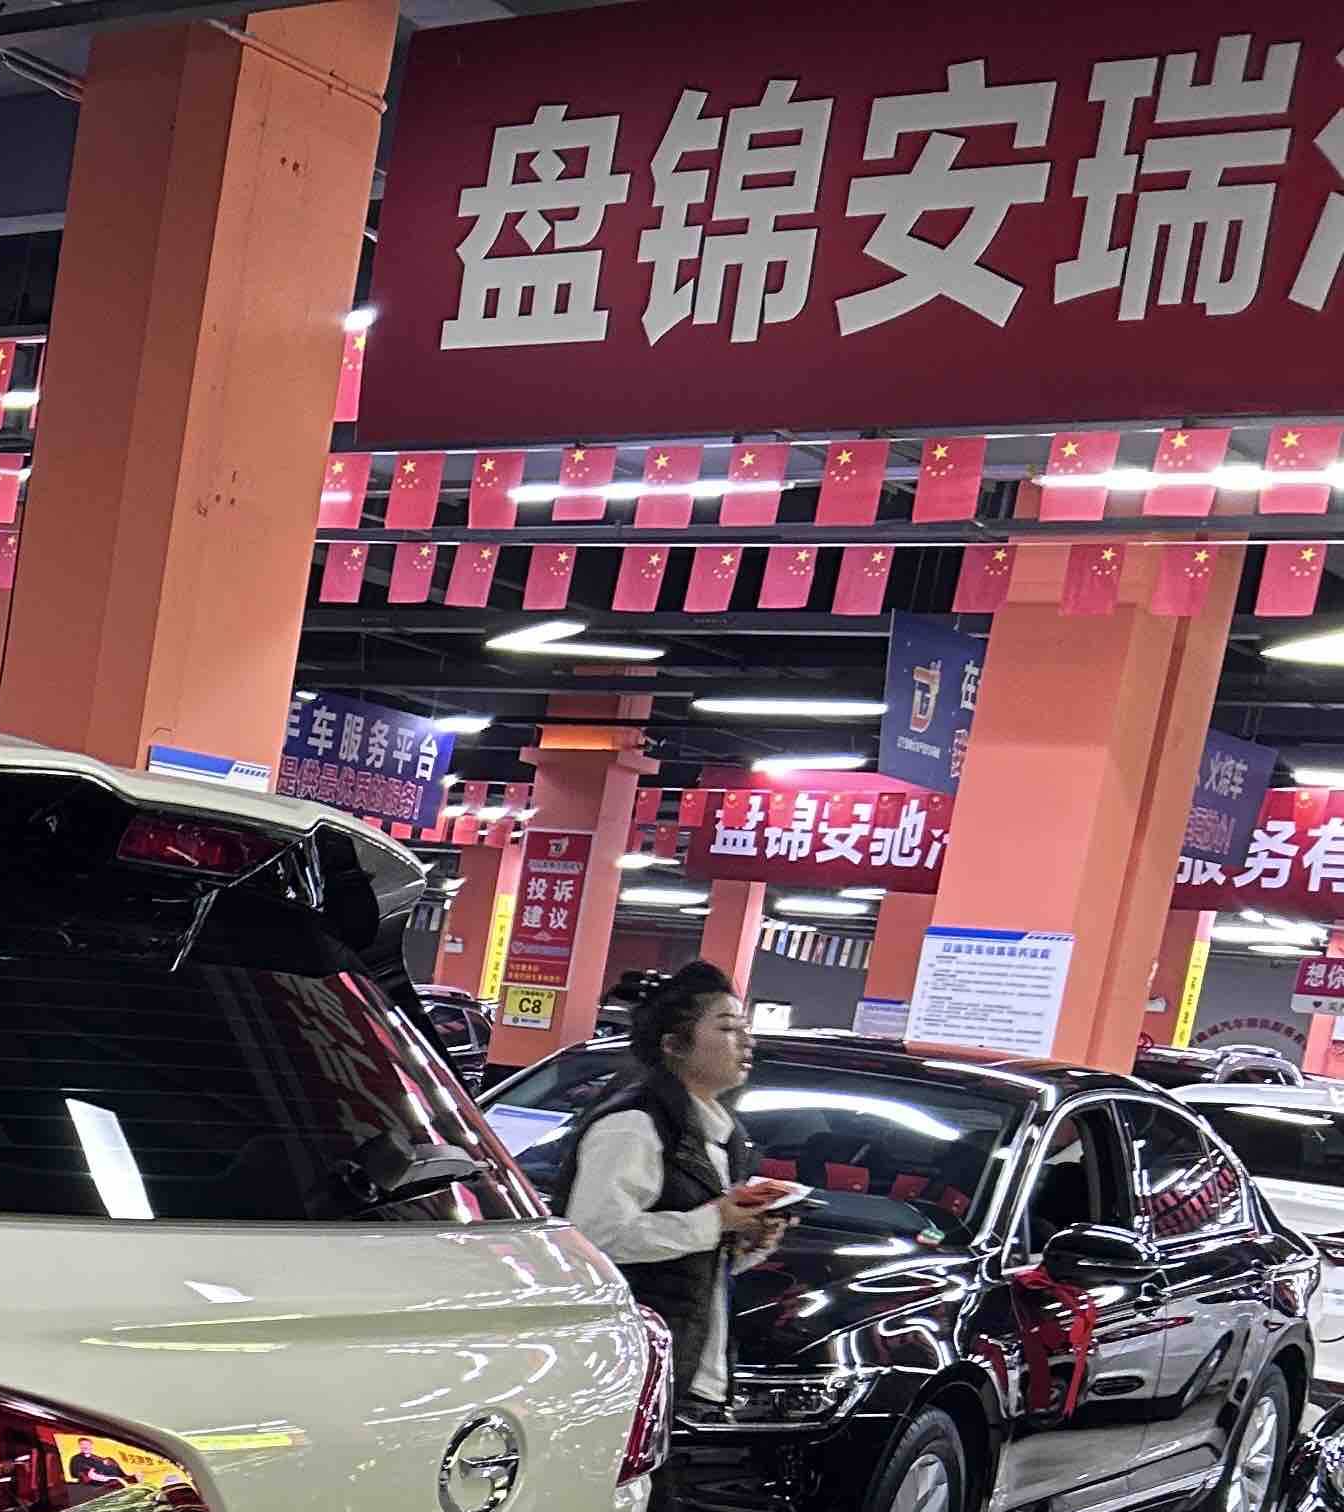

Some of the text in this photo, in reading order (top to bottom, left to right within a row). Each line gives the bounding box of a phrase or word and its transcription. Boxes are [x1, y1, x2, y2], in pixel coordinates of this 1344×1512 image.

[439, 34, 1344, 351] 盘锦安瑞
[526, 877, 576, 903] 投诉
[520, 905, 570, 930] 建议
[518, 997, 542, 1014] C8
